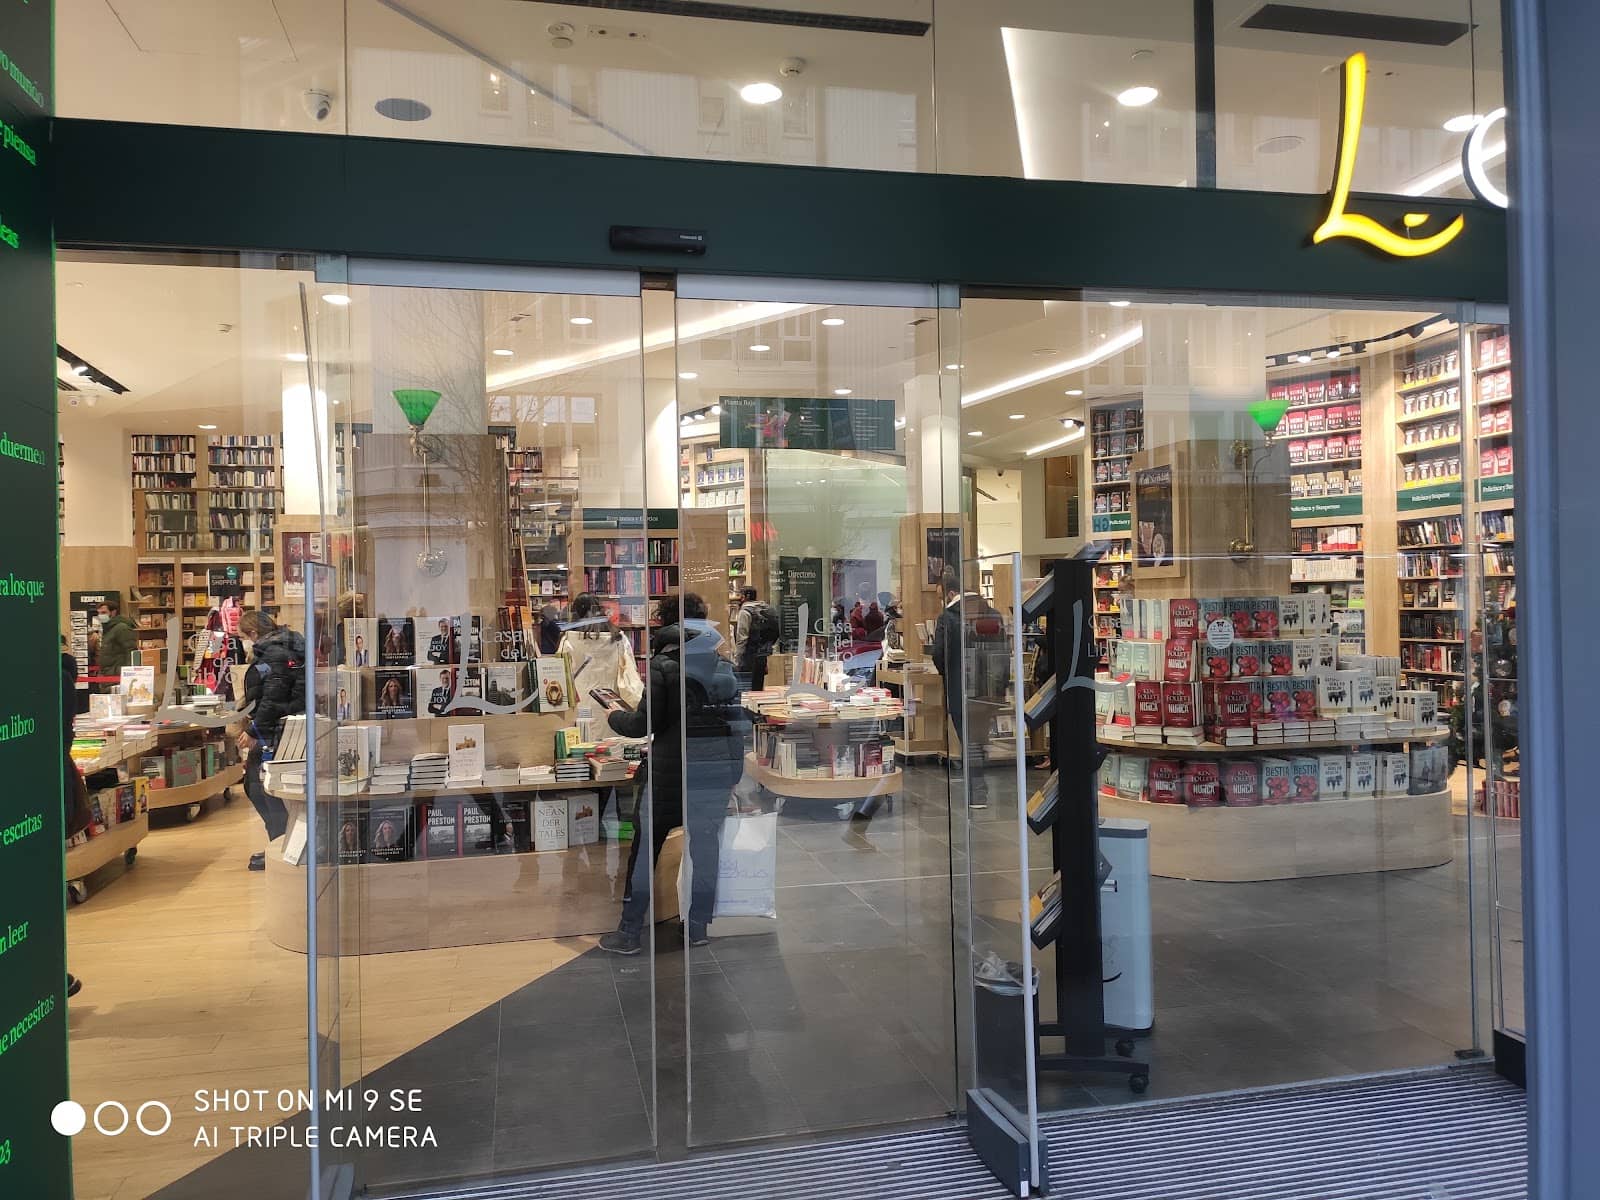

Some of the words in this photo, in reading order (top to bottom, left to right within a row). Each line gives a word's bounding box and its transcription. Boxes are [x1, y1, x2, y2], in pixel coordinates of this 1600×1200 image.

[0, 432, 46, 466] duermen
[10, 573, 26, 597] los
[26, 580, 46, 605] que
[11, 712, 36, 738] libro
[427, 808, 444, 817] PAUL
[427, 816, 455, 826] PRESTON
[463, 807, 480, 815] PAUL
[463, 814, 491, 824] PRESTON
[3, 812, 43, 847] escritas
[8, 920, 30, 949] leer
[9, 994, 55, 1046] necesitas
